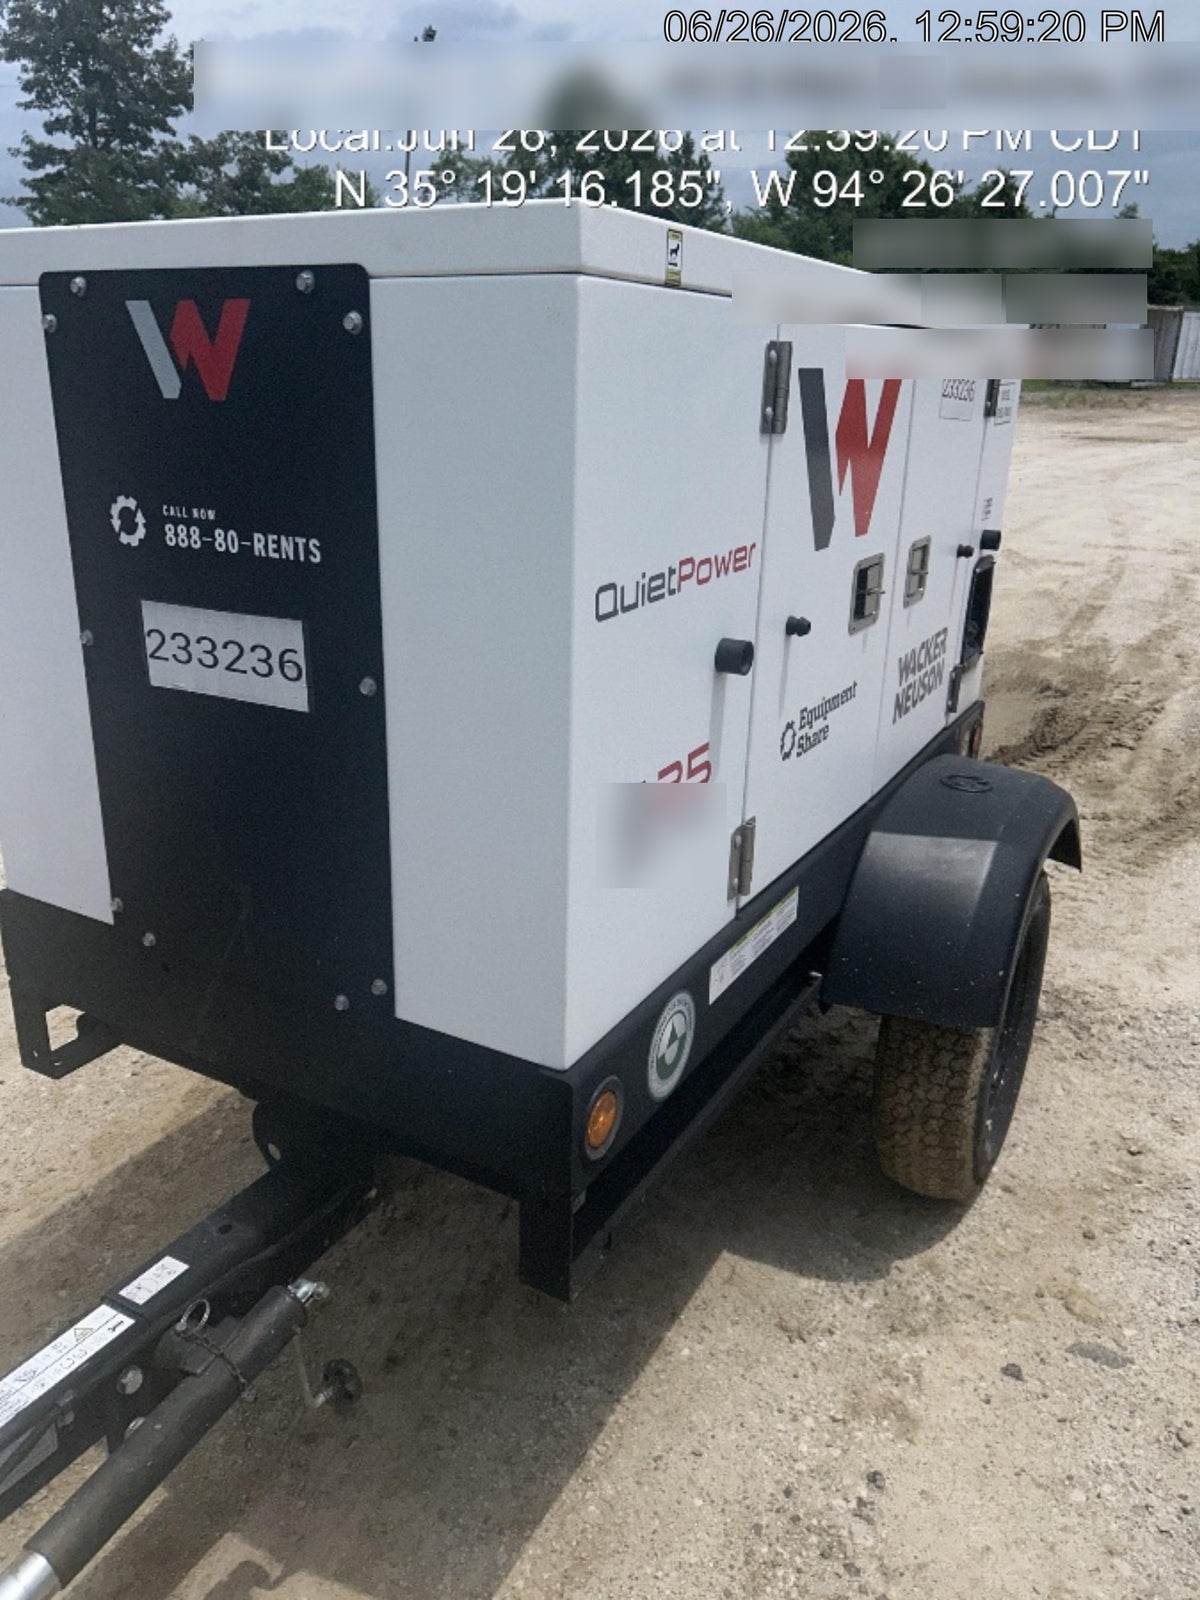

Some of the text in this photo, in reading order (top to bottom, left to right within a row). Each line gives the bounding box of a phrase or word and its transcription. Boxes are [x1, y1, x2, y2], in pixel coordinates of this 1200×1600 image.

[162, 504, 216, 520] CALL NOW
[164, 523, 322, 563] 888-80-RENTS
[594, 542, 757, 623] QuietPower
[146, 628, 303, 682] 233236
[898, 626, 949, 687] WACKER
[798, 680, 858, 731] Equipment
[892, 658, 945, 726] NEUSON
[796, 725, 830, 758] Share
